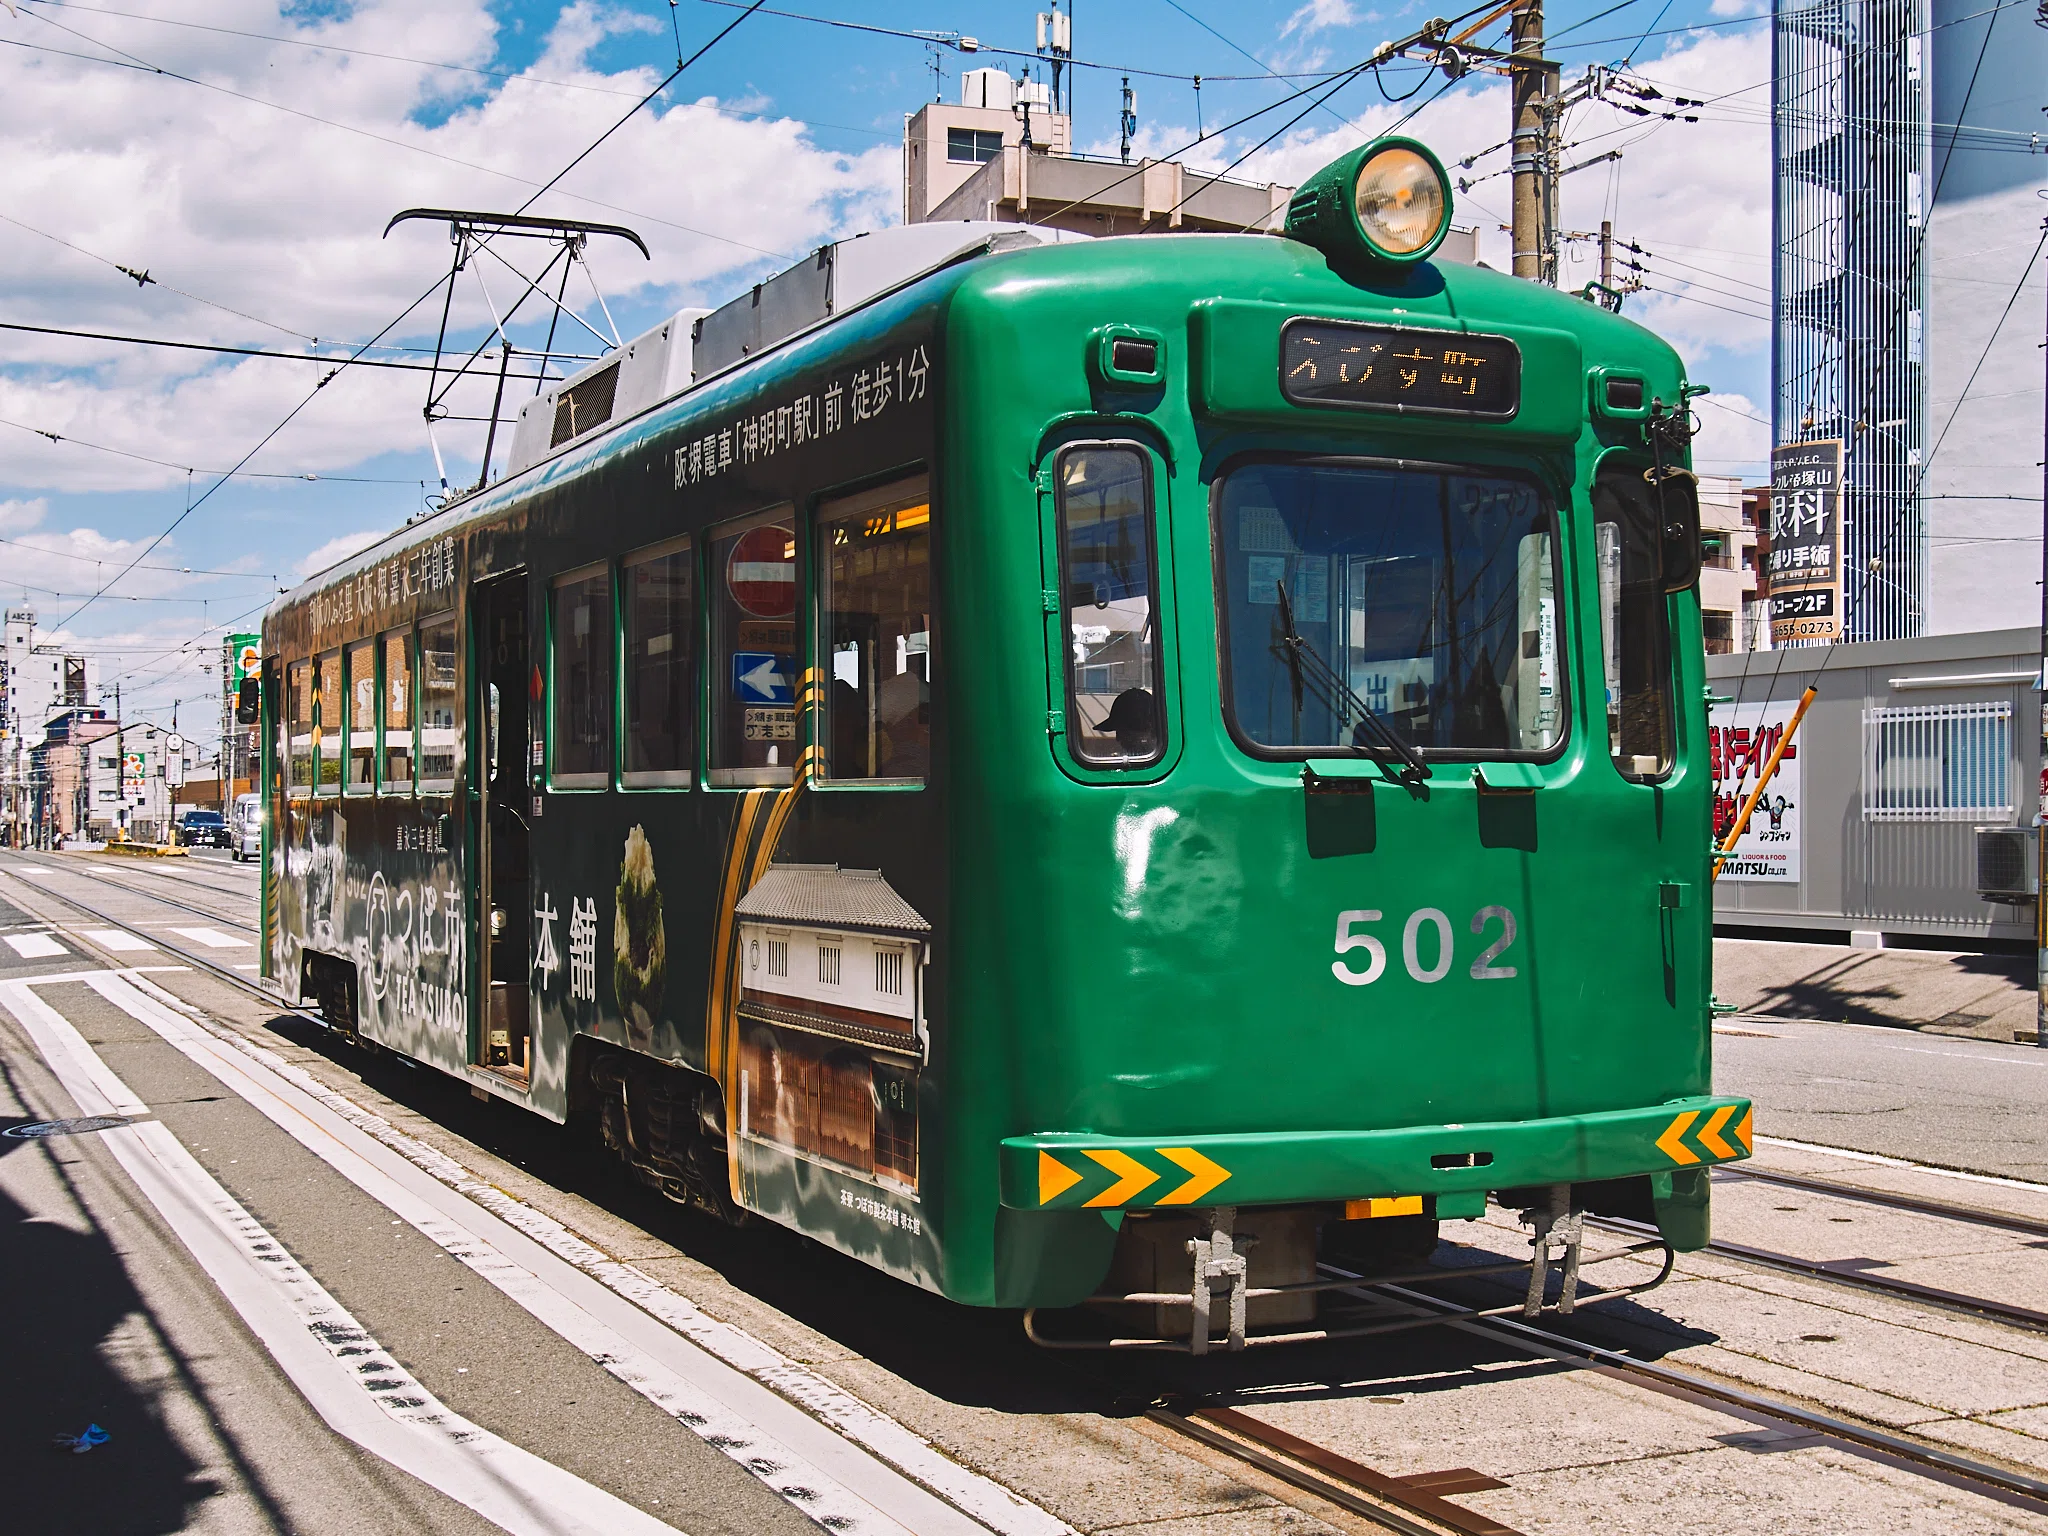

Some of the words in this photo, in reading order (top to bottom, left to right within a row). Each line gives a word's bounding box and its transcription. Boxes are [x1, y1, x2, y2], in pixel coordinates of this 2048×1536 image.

[1288, 337, 1487, 395] えびす町
[673, 381, 844, 491] 阪堺電車「神明町駅」前
[851, 344, 931, 424] 徒歩1分
[345, 862, 368, 900] 502
[1719, 861, 1768, 876] MATSU
[534, 892, 598, 1003] 本舗
[1331, 904, 1518, 987] 502
[396, 974, 416, 1016] TEA
